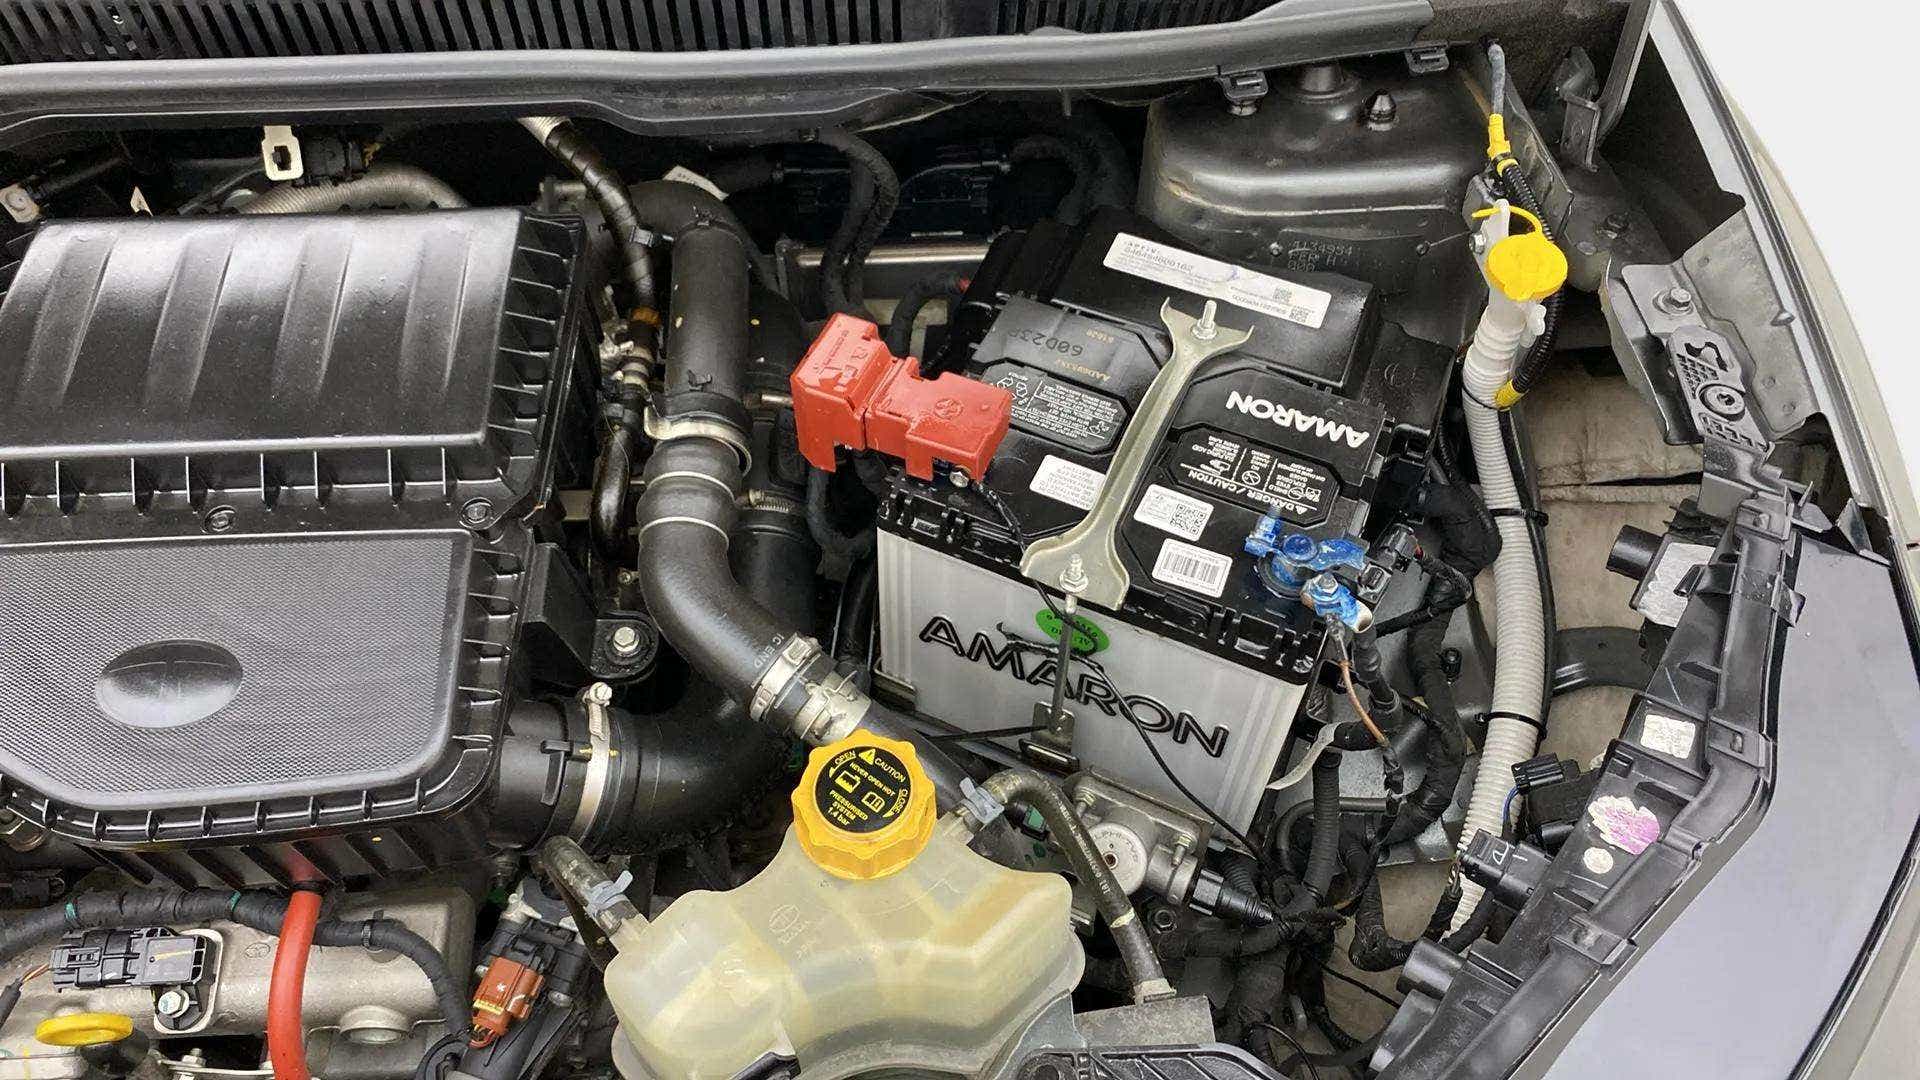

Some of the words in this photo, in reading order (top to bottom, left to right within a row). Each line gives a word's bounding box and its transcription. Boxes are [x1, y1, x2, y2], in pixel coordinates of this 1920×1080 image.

[1225, 390, 1369, 448] AMARON
[1188, 470, 1237, 493] CAUTION
[1247, 490, 1295, 511] DANGER
[918, 614, 1230, 758] AMARON
[834, 750, 857, 765] OPEN
[849, 762, 868, 778] NEVER
[867, 774, 884, 790] OPEN
[881, 785, 896, 797] HOT
[874, 757, 906, 783] CAUTION
[829, 789, 869, 821] PRESSURISED
[832, 801, 856, 820] SYSTEM
[837, 814, 850, 826] bar
